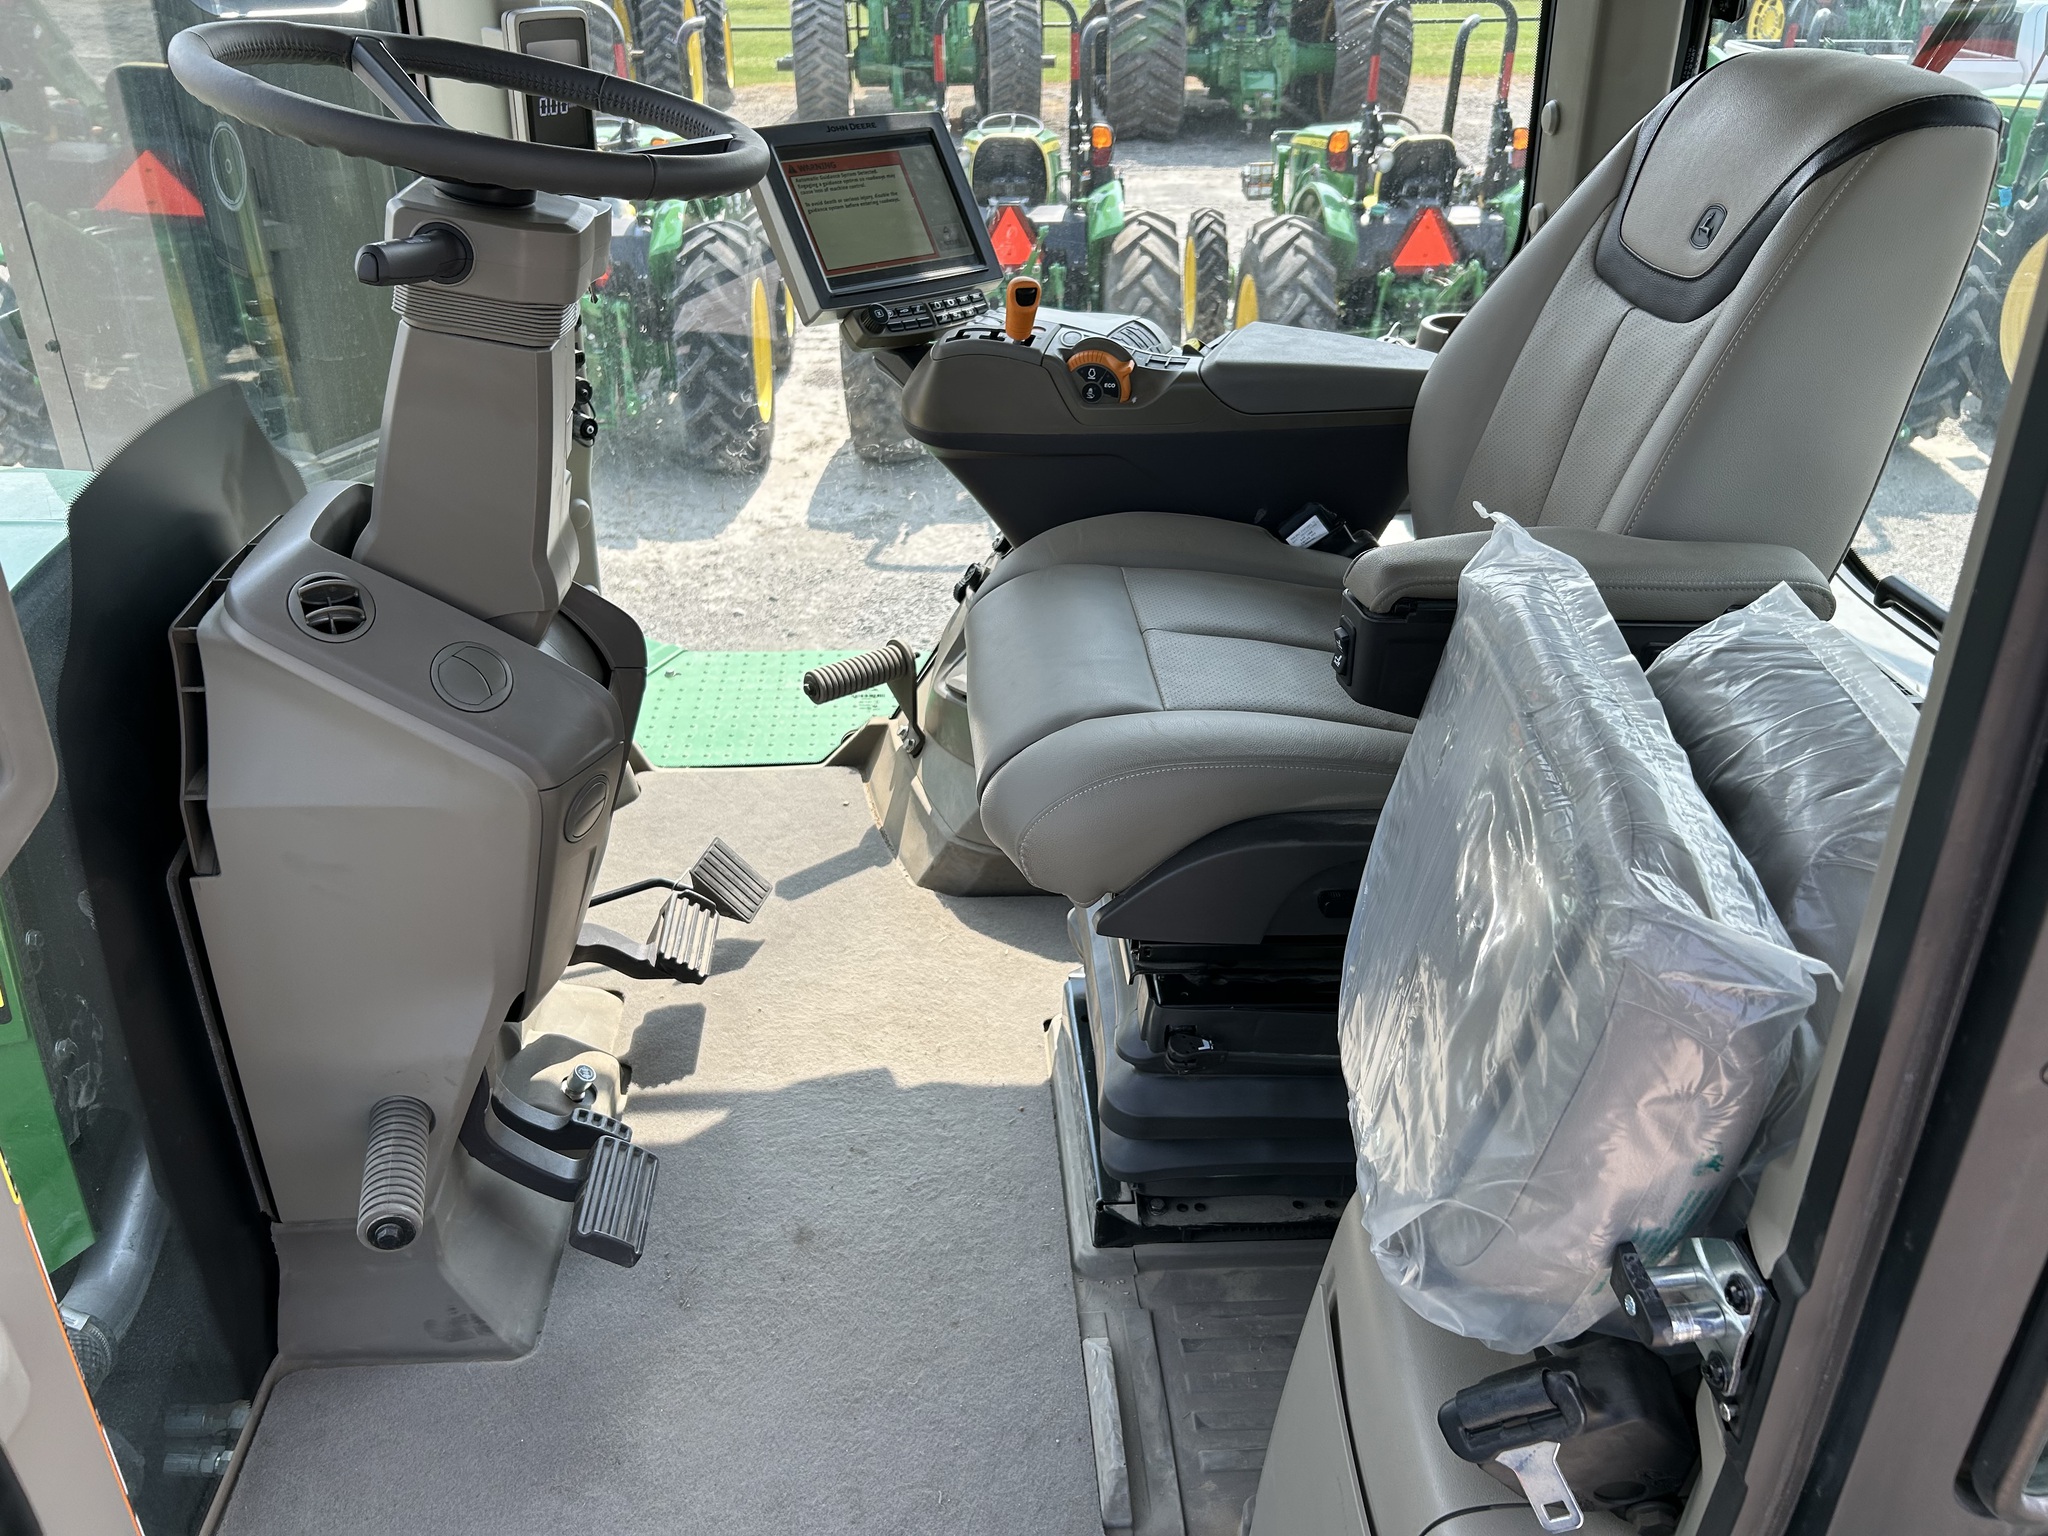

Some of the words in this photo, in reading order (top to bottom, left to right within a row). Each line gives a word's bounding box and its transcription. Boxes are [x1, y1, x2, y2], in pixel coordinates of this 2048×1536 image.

[826, 124, 849, 133] JOHN
[849, 122, 878, 131] DEERE
[797, 162, 837, 172] WARNING
[822, 179, 842, 187] guidance
[807, 206, 828, 214] guidance
